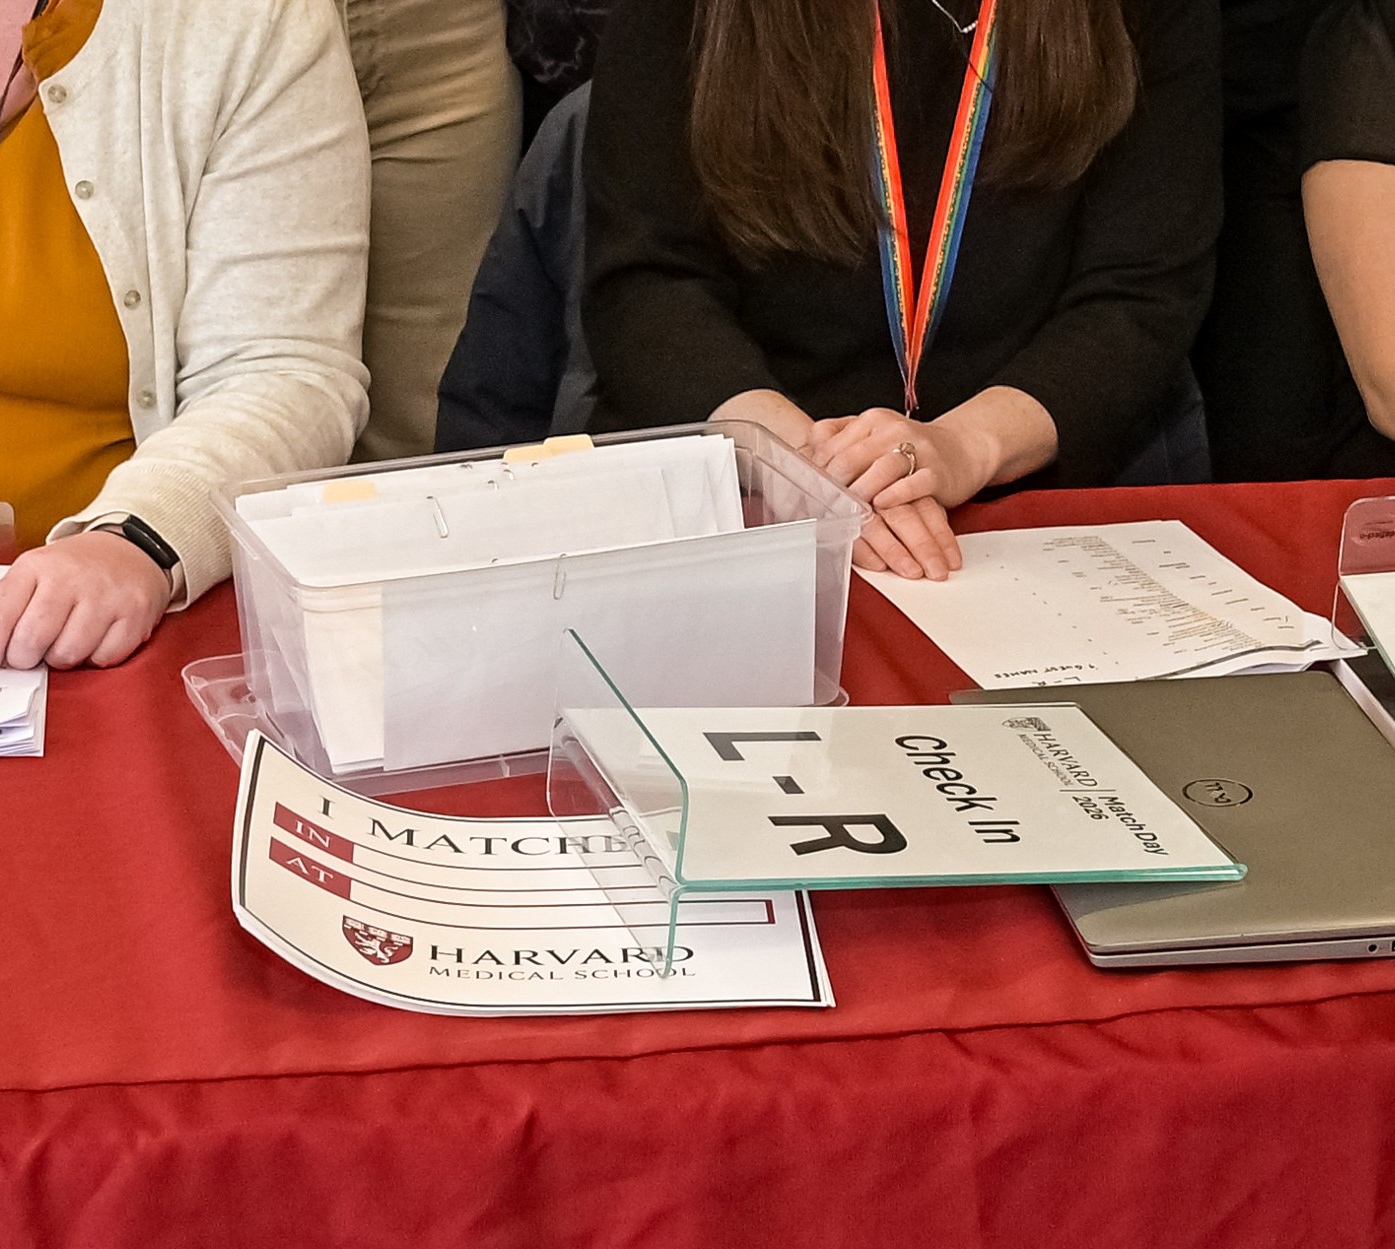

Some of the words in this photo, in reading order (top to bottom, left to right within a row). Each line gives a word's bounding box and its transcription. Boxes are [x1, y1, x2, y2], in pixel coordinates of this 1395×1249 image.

[894, 734, 998, 813] Check
[968, 821, 1021, 844] In
[1034, 733, 1098, 788] HARVARD
[1098, 796, 1145, 832] Match
[1134, 833, 1169, 856] Day
[316, 796, 336, 820] I
[1072, 796, 1109, 821] 2026
[294, 820, 332, 849] IN
[286, 857, 334, 887] AT
[429, 944, 696, 967] HARVARD
[429, 966, 565, 982] MEDICAL
[574, 967, 696, 982] SCHOOL
